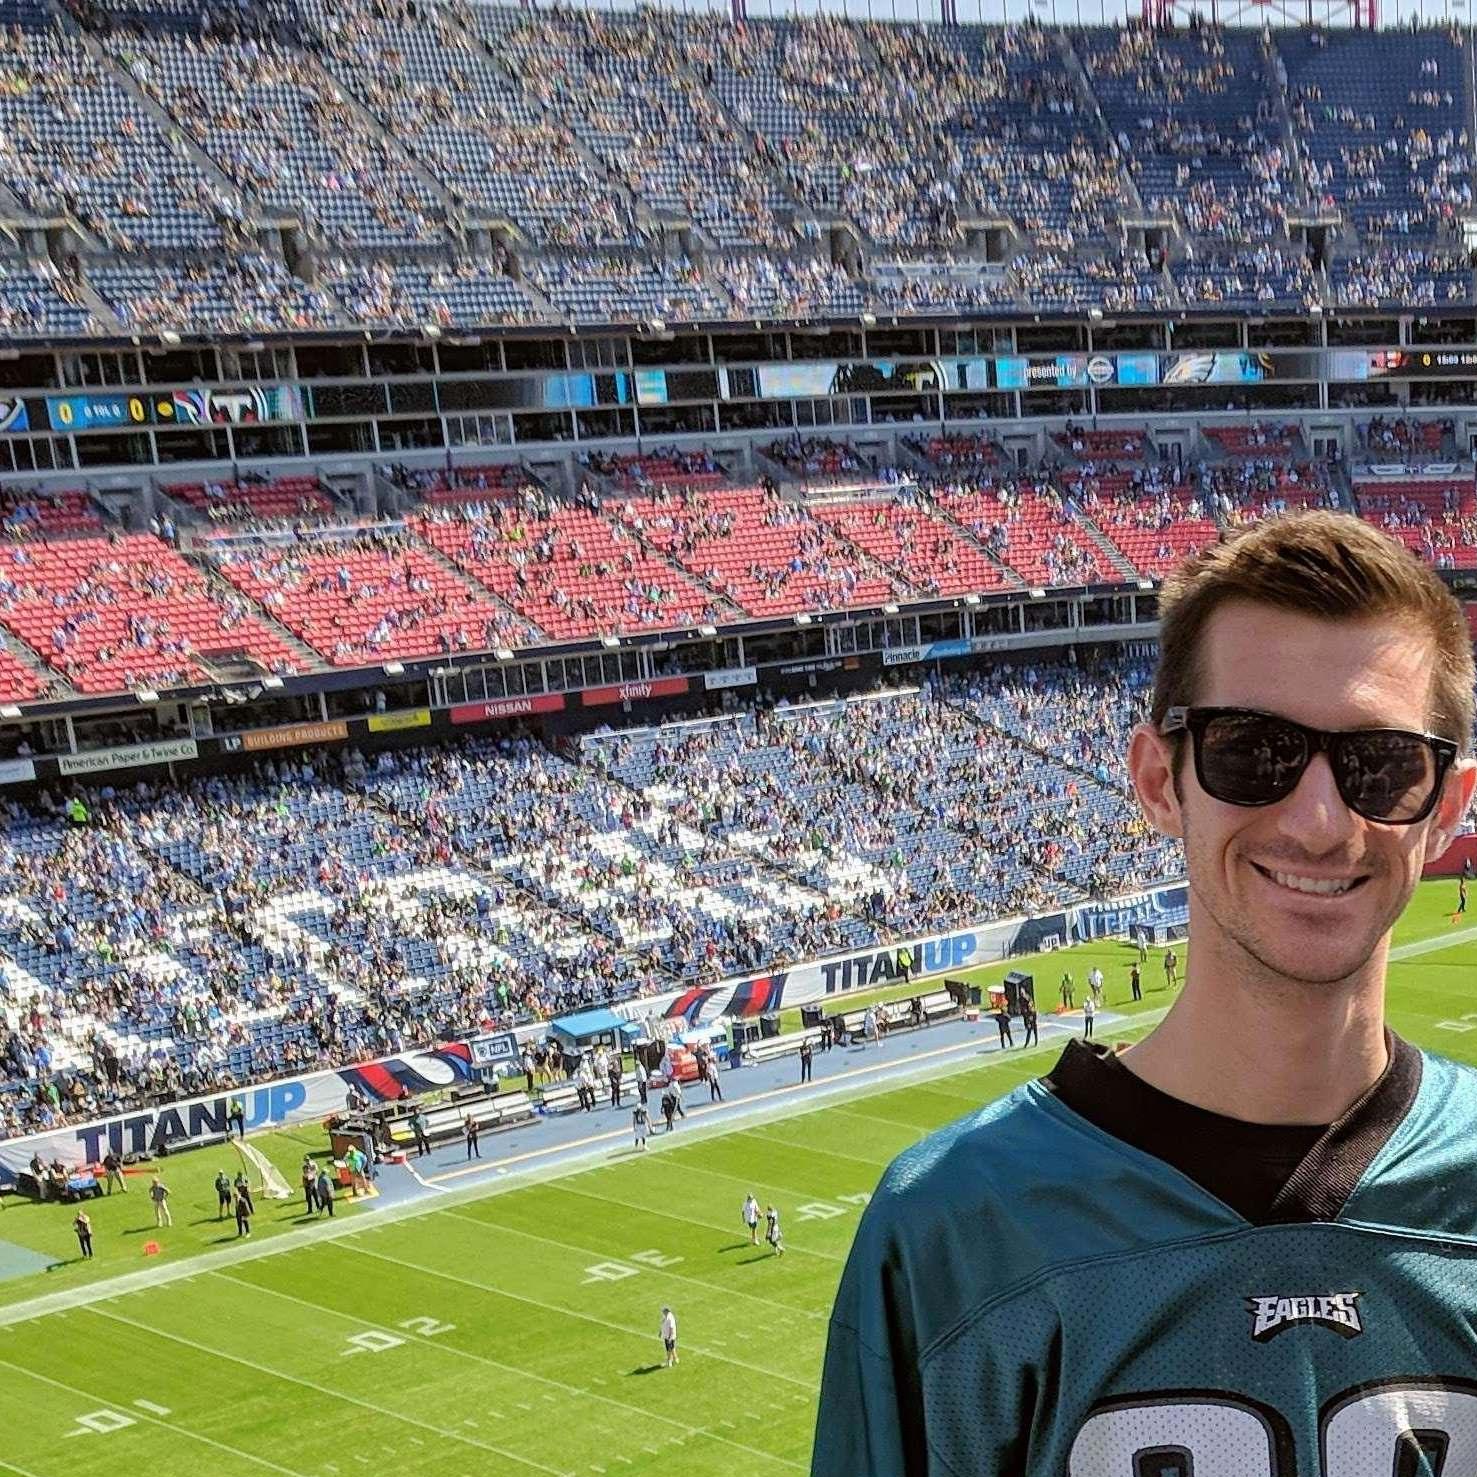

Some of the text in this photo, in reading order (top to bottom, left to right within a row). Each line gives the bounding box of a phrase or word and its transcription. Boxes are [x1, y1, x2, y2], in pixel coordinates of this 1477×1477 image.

[485, 700, 533, 716] NISSAN
[618, 683, 652, 701] xfinity
[821, 933, 978, 995] TITAN UP
[76, 1081, 306, 1165] TITAN UP
[1250, 1290, 1362, 1342] EAGLES
